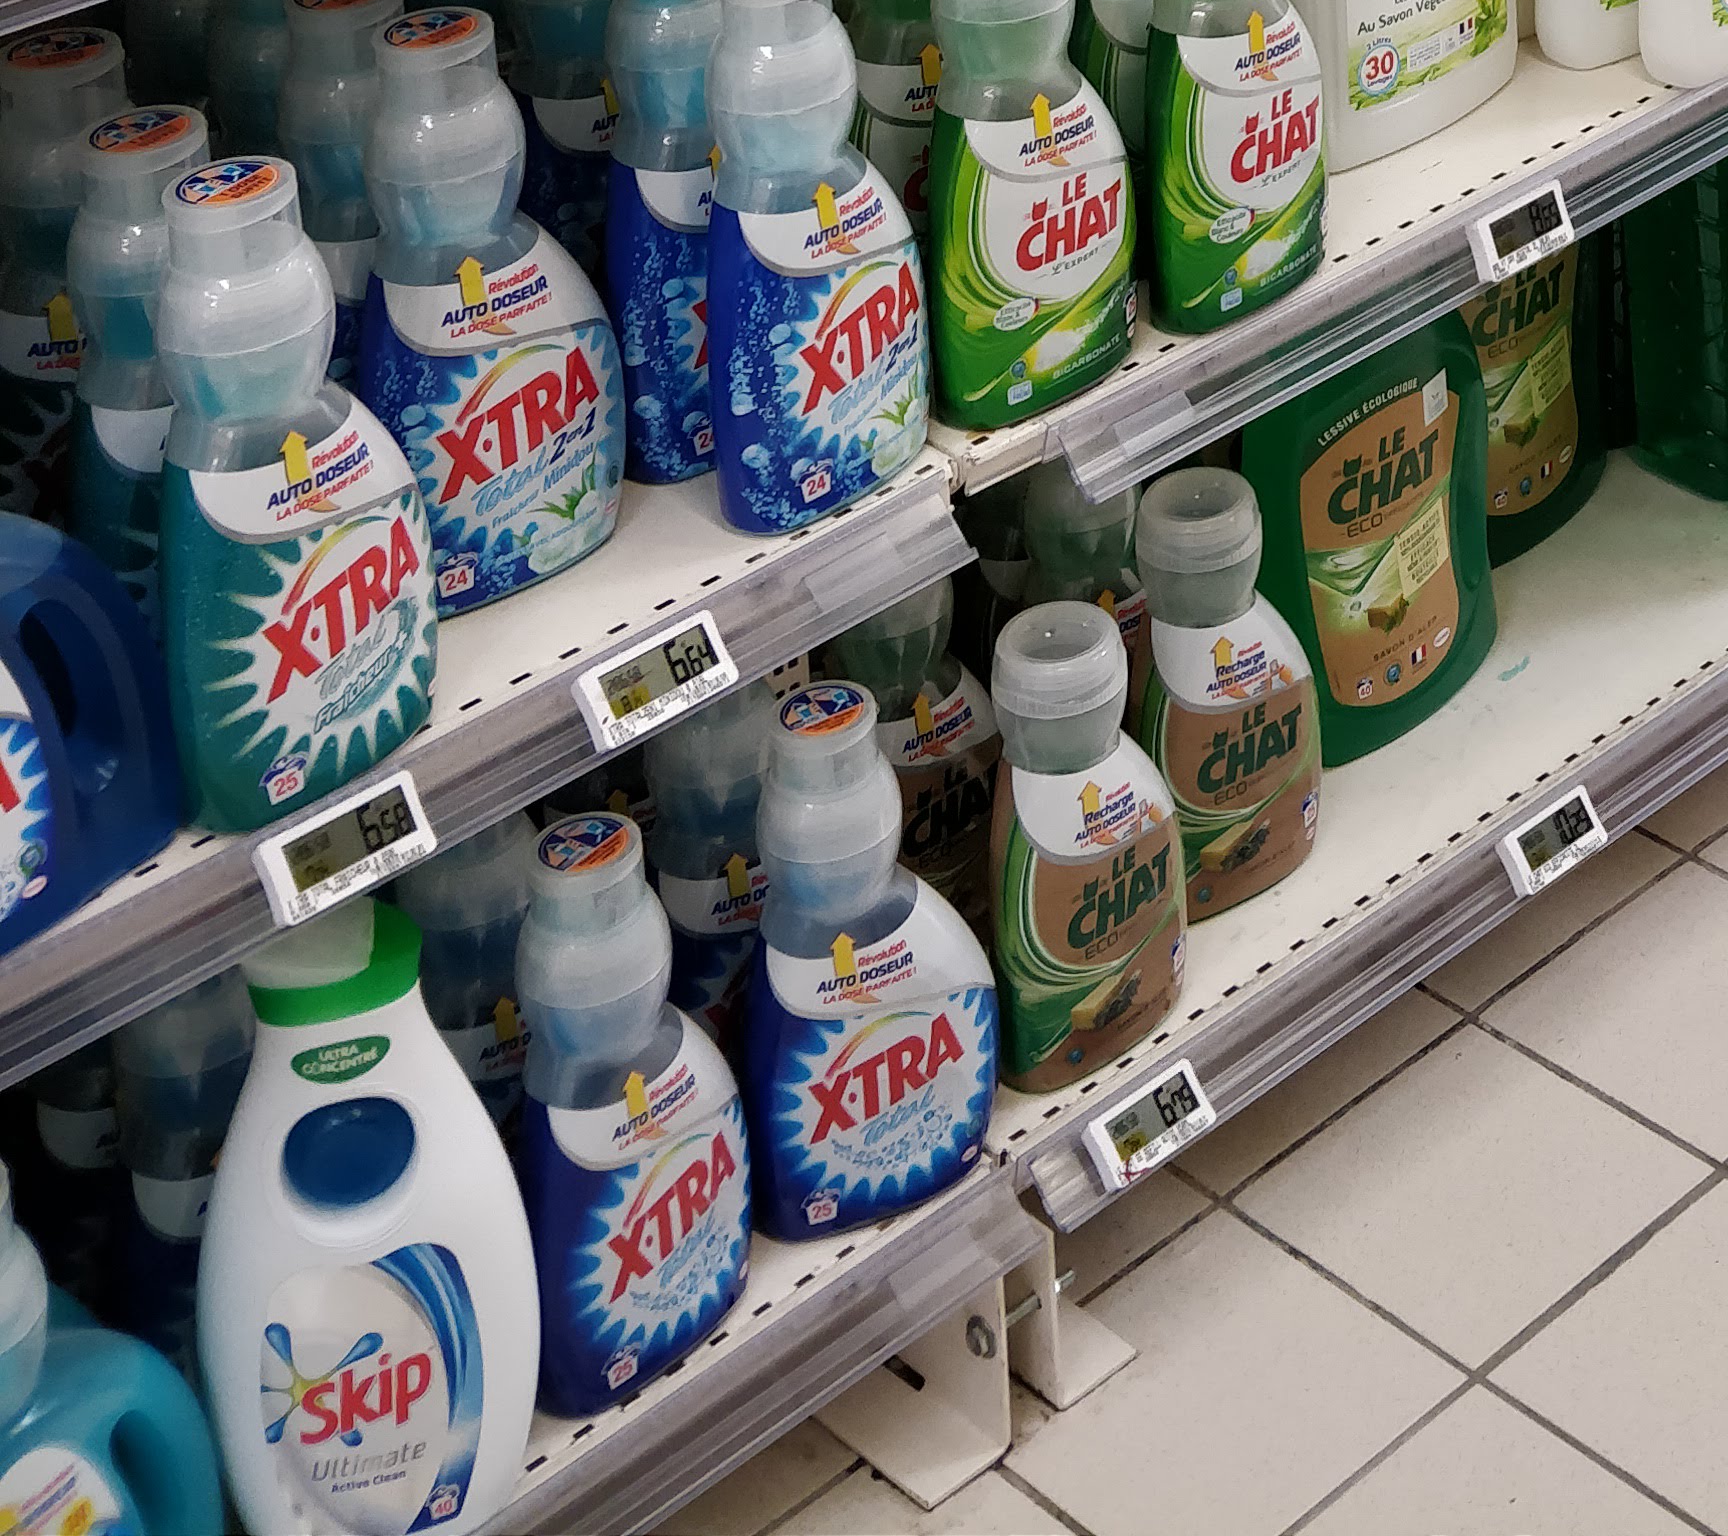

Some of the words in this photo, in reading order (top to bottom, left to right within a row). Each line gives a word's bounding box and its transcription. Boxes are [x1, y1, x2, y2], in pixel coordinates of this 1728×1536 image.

[1357, 20, 1375, 36] Au
[1379, 6, 1414, 28] Savon
[1365, 52, 1394, 79] 30
[1272, 89, 1293, 122] LE
[1019, 138, 1051, 157] AUTO
[1054, 115, 1095, 146] DOSEUR
[1231, 94, 1320, 183] CHAT
[1062, 173, 1087, 205] LE
[1016, 179, 1121, 272] CHAT
[1318, 406, 1361, 447] LESSIVE
[1362, 377, 1418, 415] ÉCOLOGIQUE
[1378, 426, 1406, 462] LE
[543, 442, 593, 493] Minidou
[1328, 429, 1439, 524] CHAT
[1196, 706, 1301, 794] CHAT
[1084, 790, 1134, 826] Recharge
[302, 1046, 378, 1076] CONCENTRÉ
[318, 1044, 359, 1063] ULTRA
[299, 1353, 434, 1444] Skip
[311, 1440, 428, 1483] Ultimate
[331, 1478, 370, 1494] Active
[373, 1469, 406, 1486] Clean
